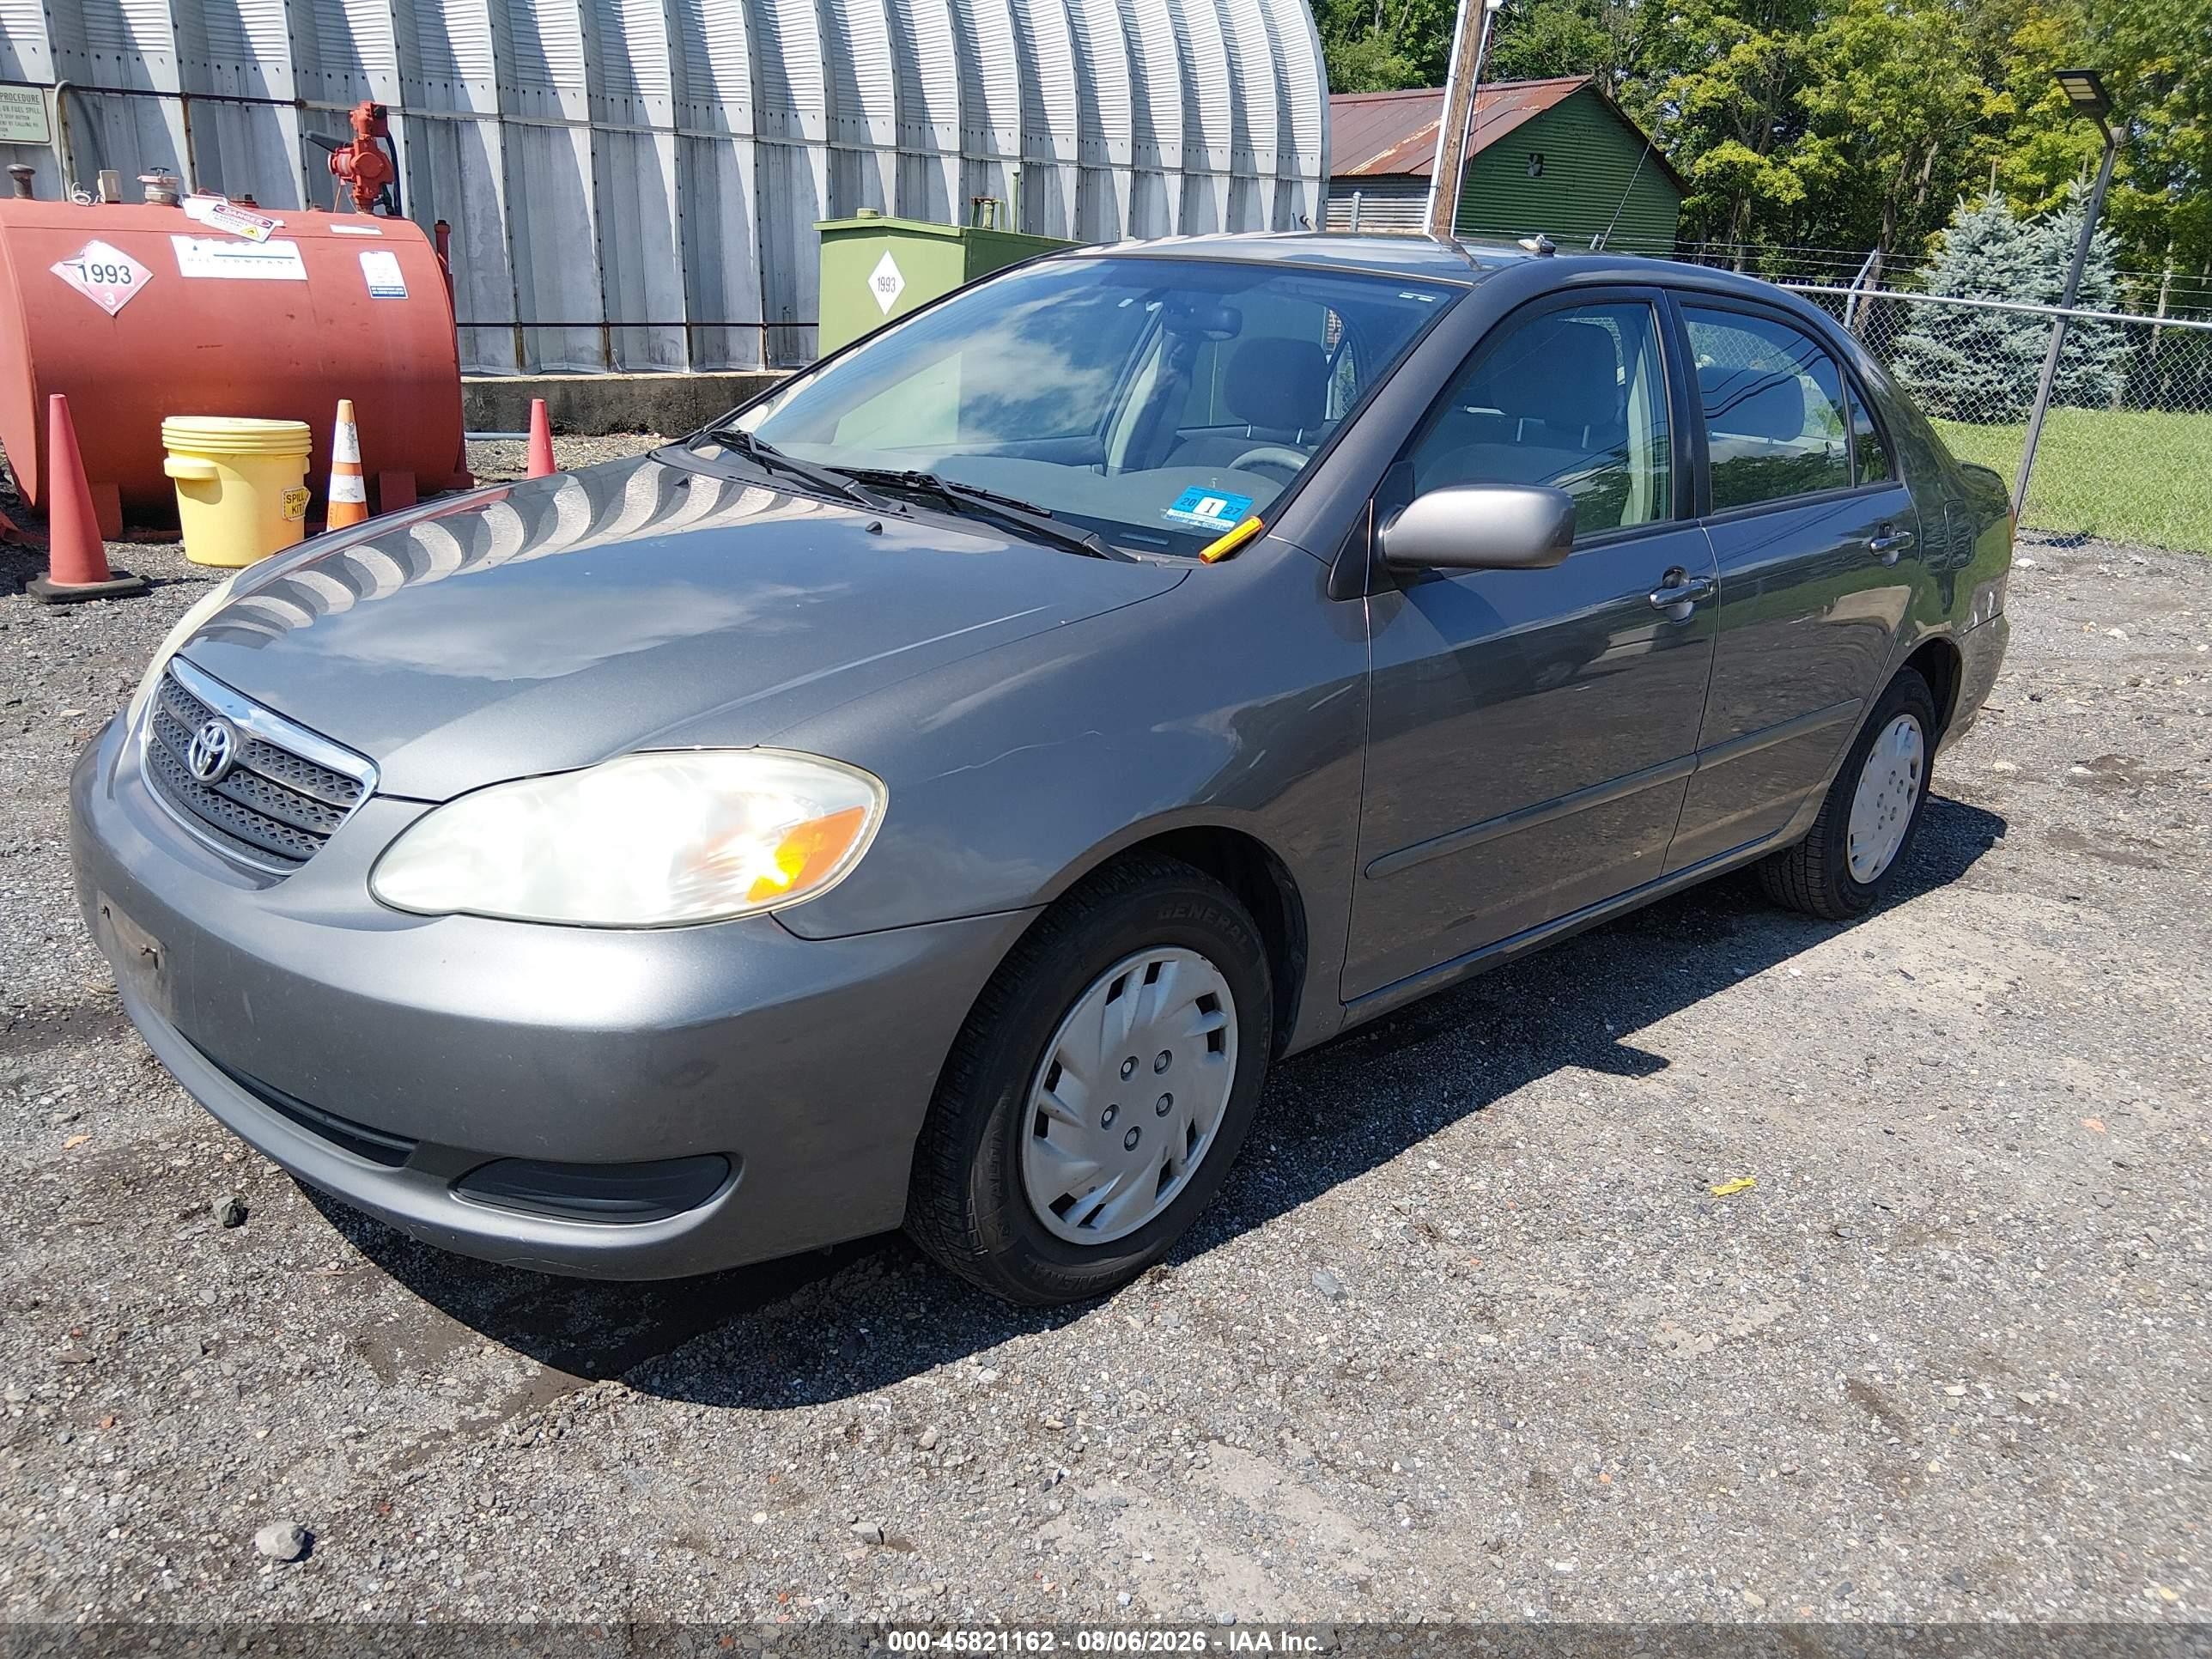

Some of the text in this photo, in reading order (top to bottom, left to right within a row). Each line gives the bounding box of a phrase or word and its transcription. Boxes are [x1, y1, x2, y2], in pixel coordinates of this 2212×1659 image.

[0, 93, 40, 103] PROCEDURE
[224, 207, 264, 226] DANGER
[77, 263, 132, 285] 1993
[877, 276, 896, 293] 1993
[104, 291, 117, 306] 3
[286, 490, 305, 504] SPILL
[291, 503, 302, 515] KIT
[1181, 497, 1243, 516] 20 1 27
[1156, 902, 1249, 949] GENERAL
